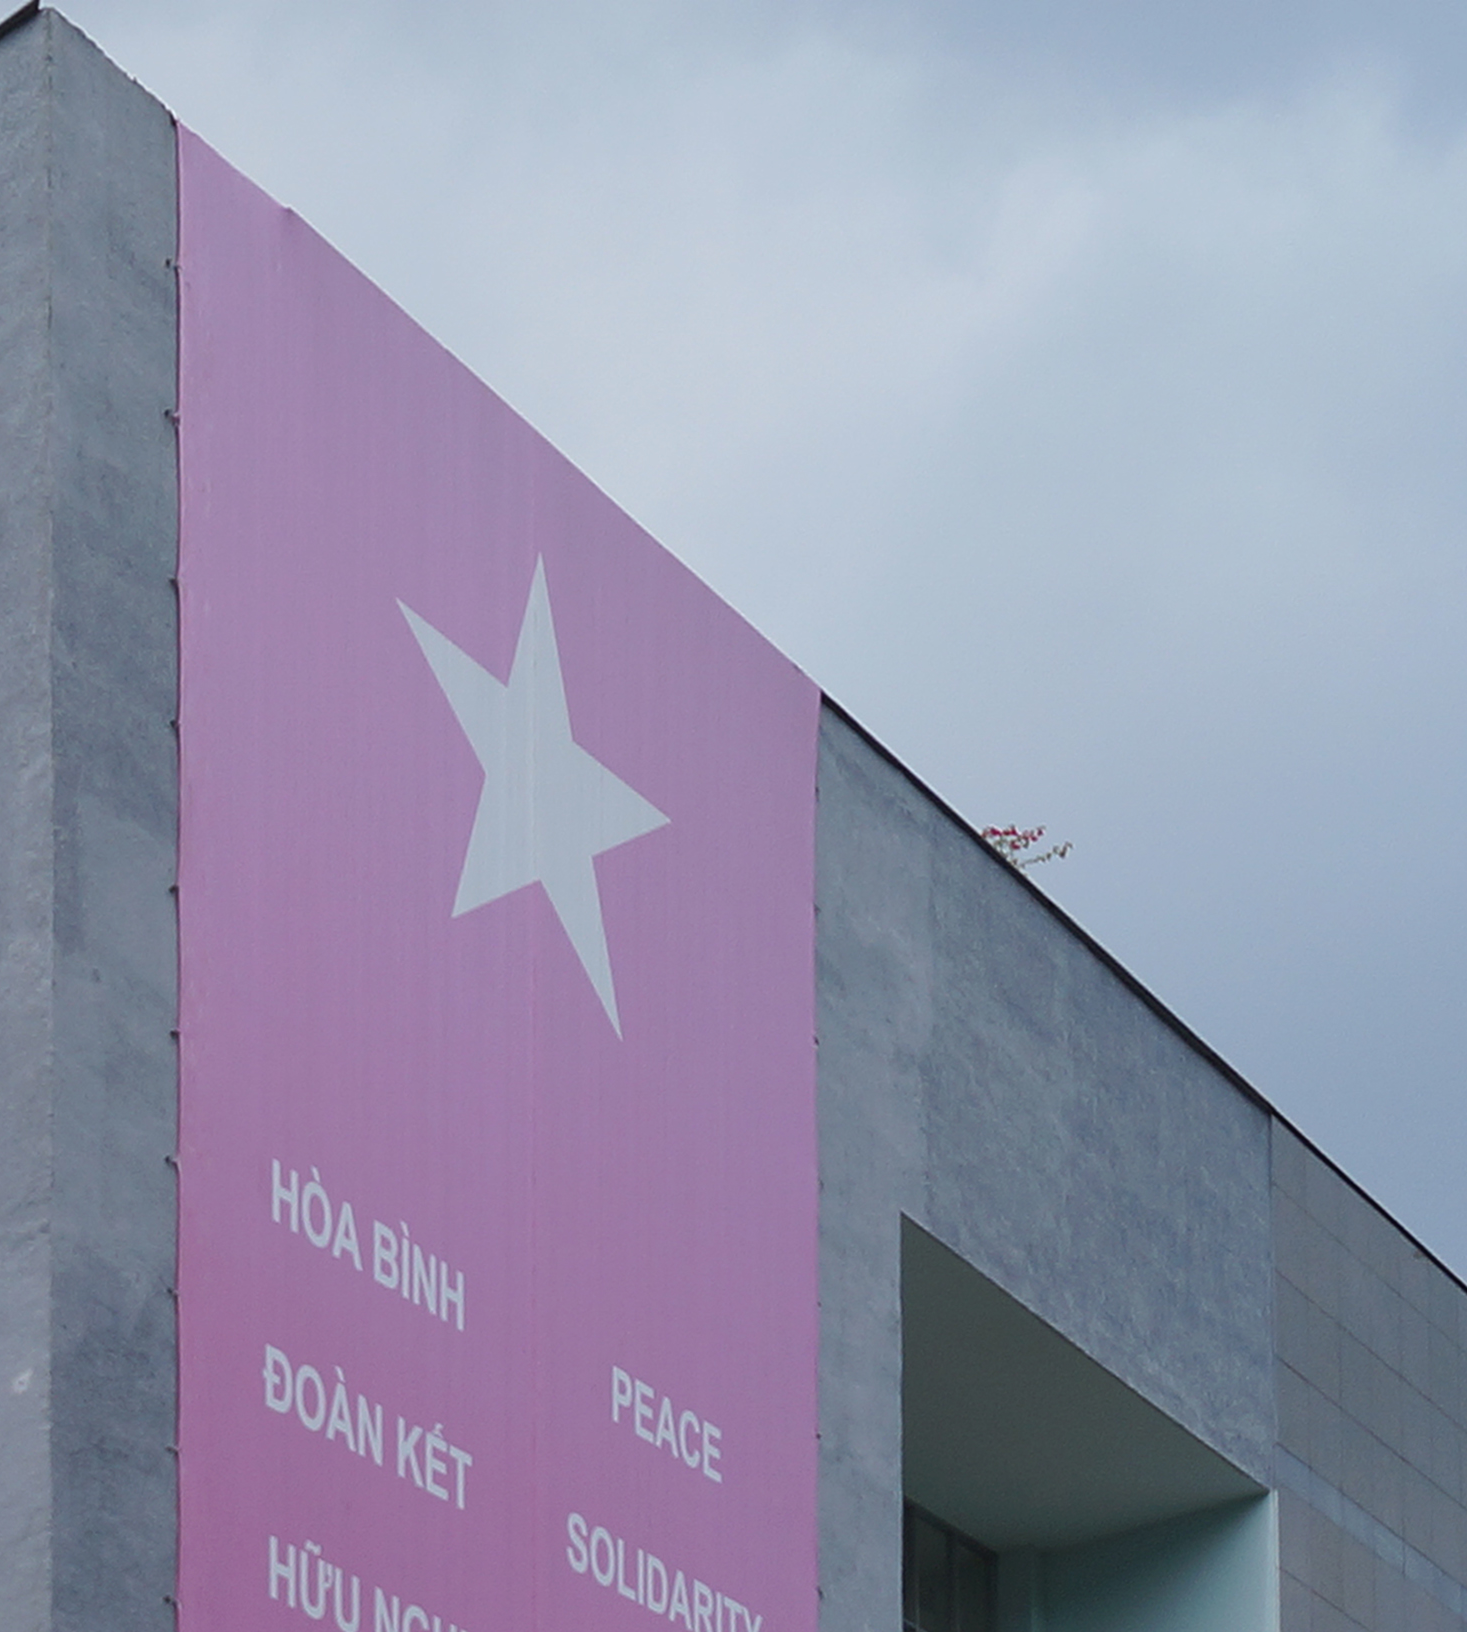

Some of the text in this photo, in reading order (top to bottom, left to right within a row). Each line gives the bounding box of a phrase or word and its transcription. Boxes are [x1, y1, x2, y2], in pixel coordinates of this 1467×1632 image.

[271, 1160, 466, 1331] HÒA BÌNH
[262, 1345, 473, 1508] ĐOÀN KẾT
[611, 1366, 723, 1483] PEACE
